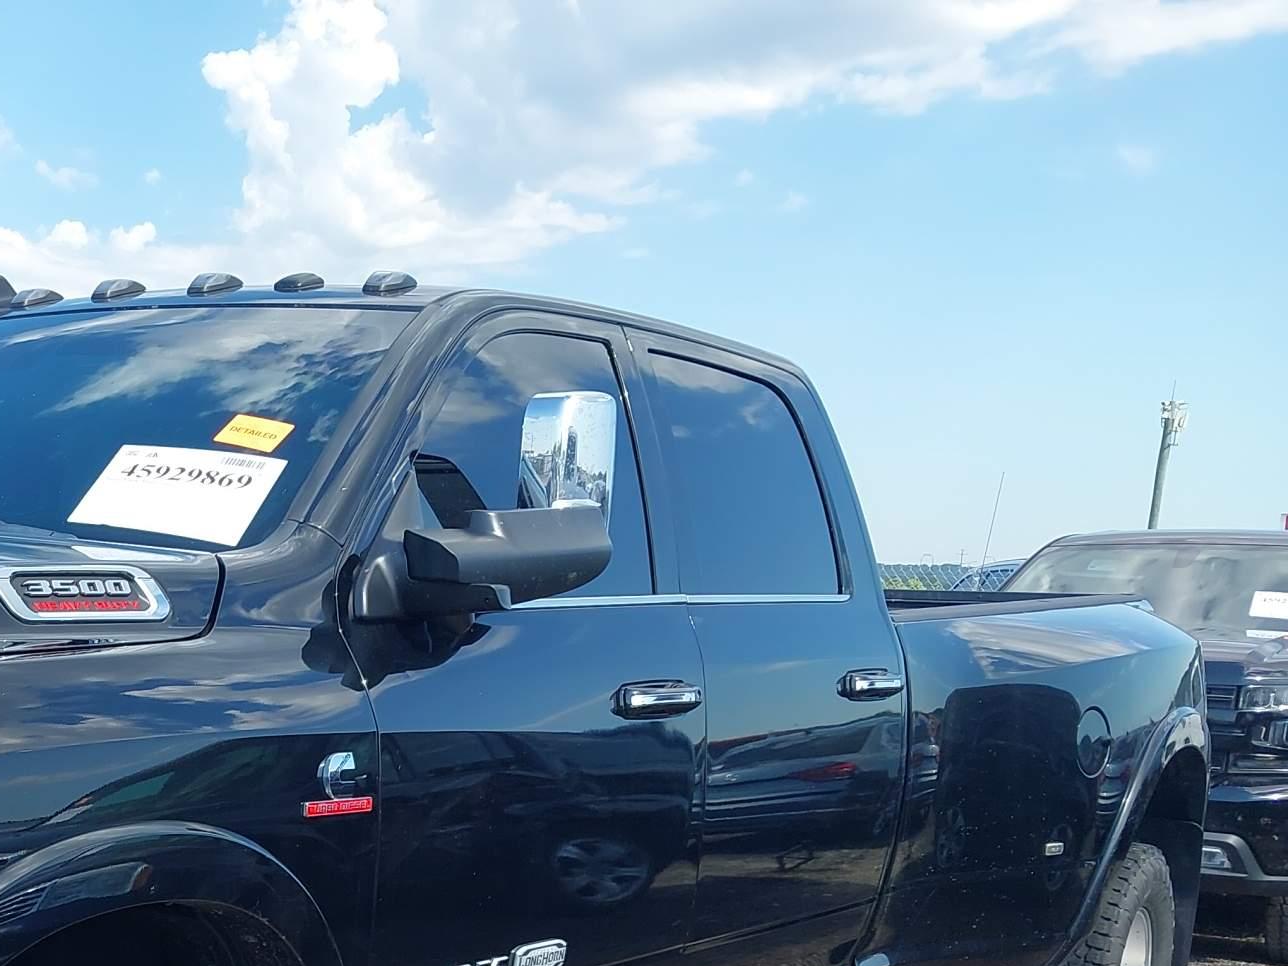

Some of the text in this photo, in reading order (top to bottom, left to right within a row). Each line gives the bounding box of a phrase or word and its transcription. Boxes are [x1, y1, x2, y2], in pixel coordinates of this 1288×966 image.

[230, 426, 277, 439] DETAILED
[120, 463, 253, 489] 45929869
[22, 579, 132, 597] 3500
